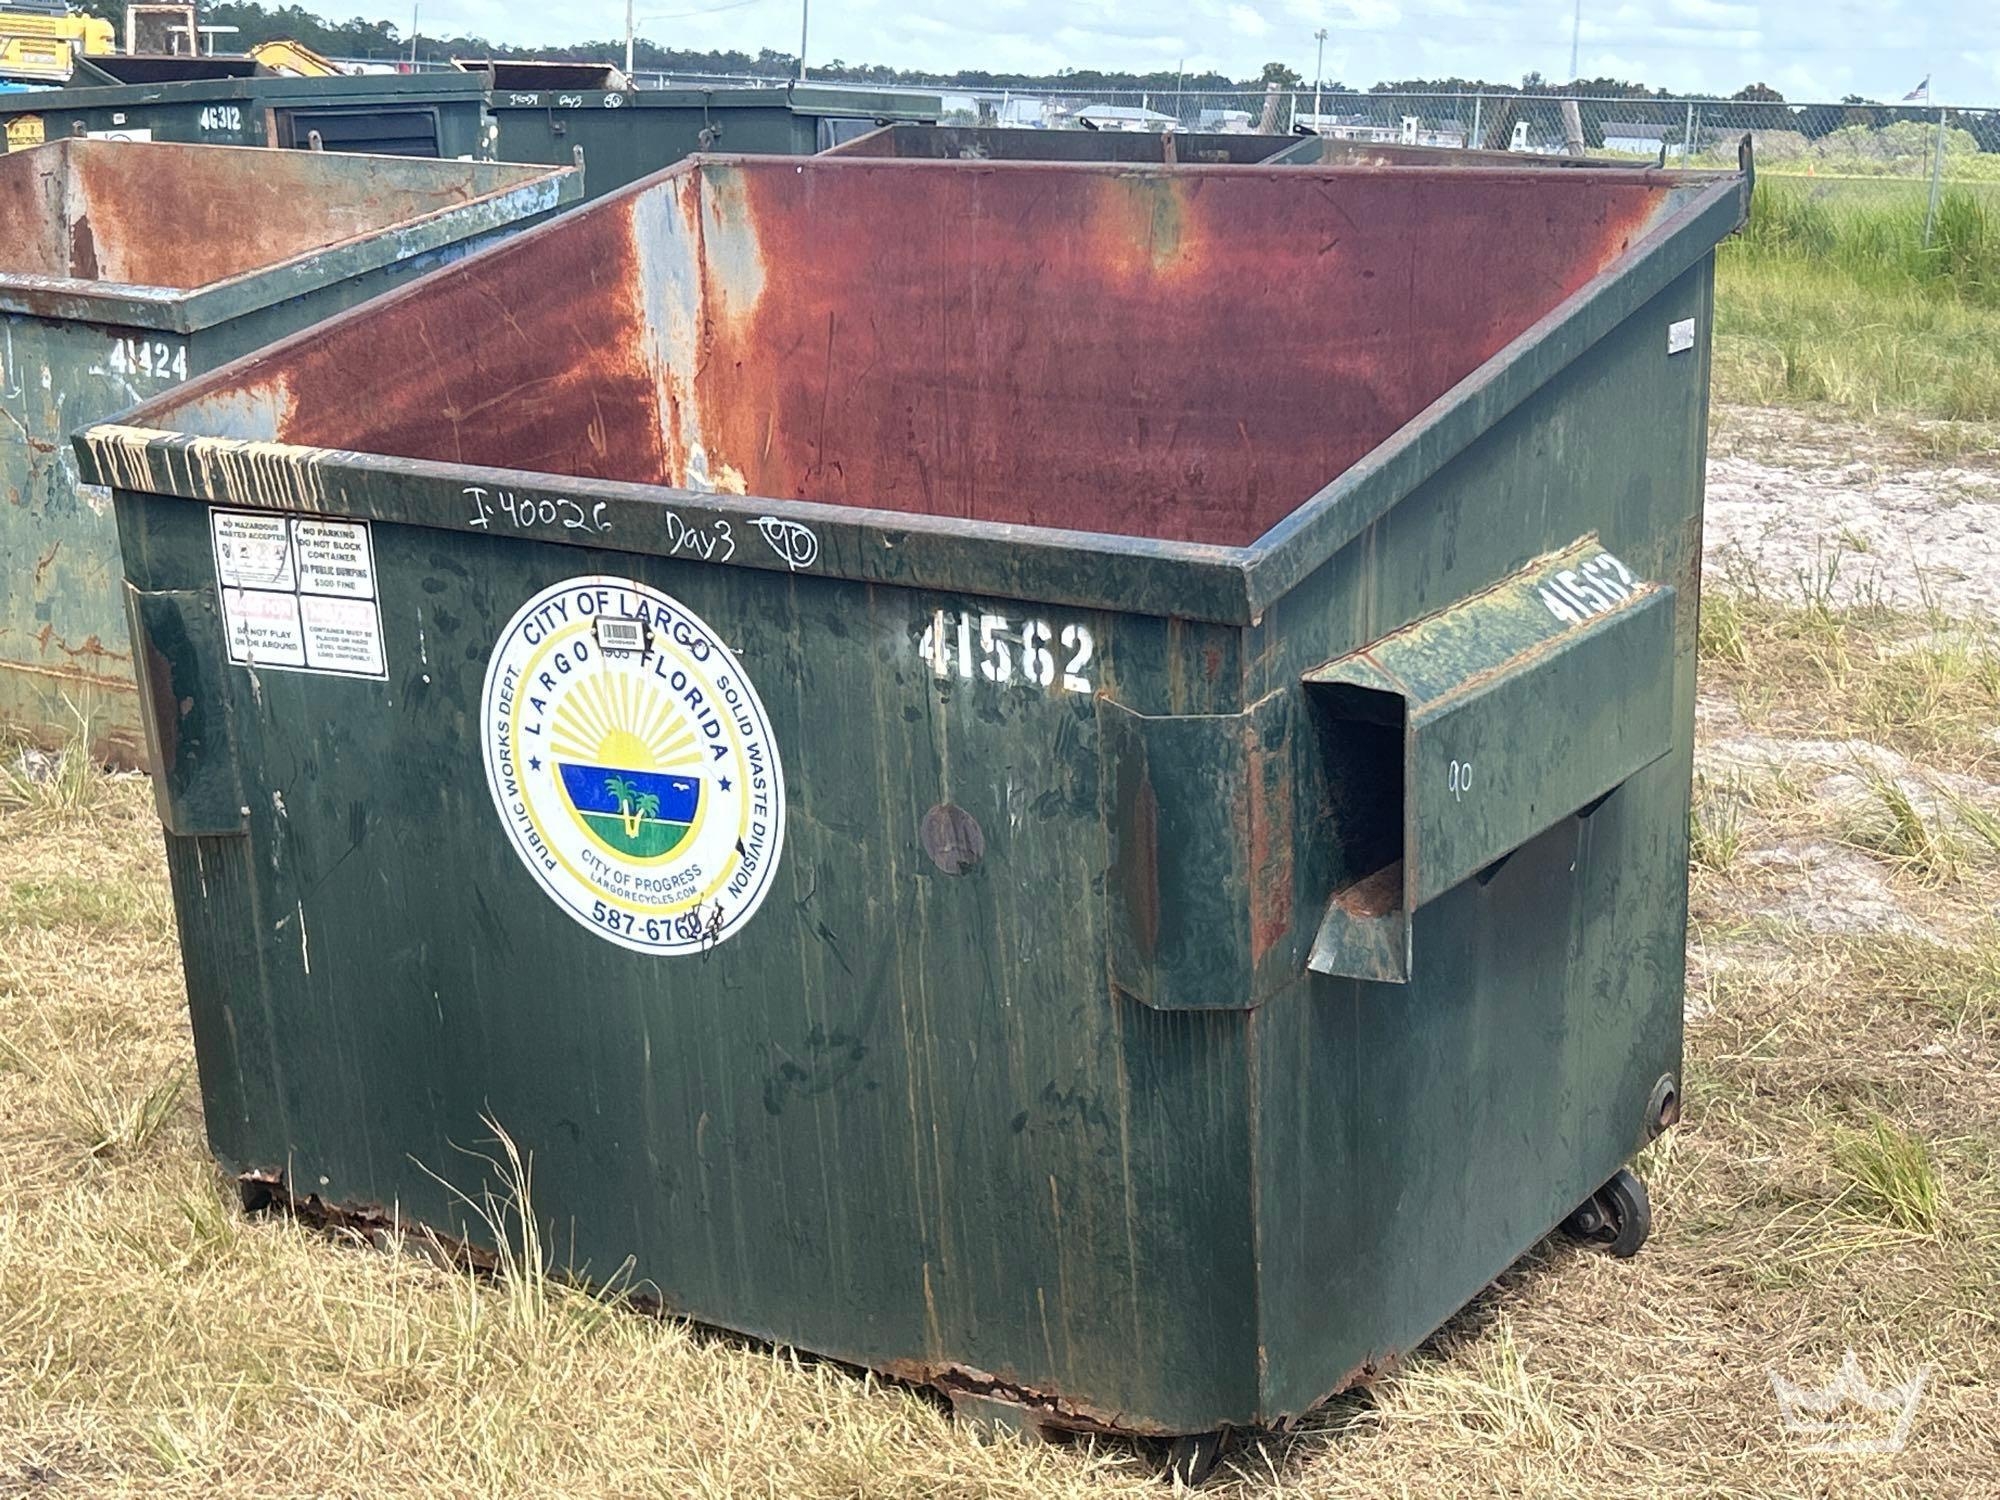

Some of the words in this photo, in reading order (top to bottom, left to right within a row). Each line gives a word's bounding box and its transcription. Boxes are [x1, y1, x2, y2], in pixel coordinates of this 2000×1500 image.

[110, 338, 188, 381] 41424
[235, 522, 279, 531] HAZARDOUS
[248, 533, 286, 541] ACCEPTED
[303, 528, 315, 536] NO
[318, 529, 355, 539] PARKING
[314, 540, 330, 549] NOT
[333, 541, 361, 551] BLOCK
[307, 551, 356, 562] CONTAINER
[310, 565, 334, 575] PUBLIC
[337, 581, 355, 590] FINE
[250, 628, 267, 637] NOT
[270, 630, 291, 639] PLAY
[262, 640, 298, 650] AROUND
[523, 597, 568, 645] CITY
[577, 590, 609, 615] OF
[620, 593, 711, 662] LARGO
[918, 609, 1094, 693] 41562
[525, 640, 589, 735] LARGO
[641, 648, 728, 762] FLORIDA
[716, 675, 753, 736] SOLID
[498, 721, 519, 797] WORKS
[747, 742, 767, 818] WASTE
[513, 802, 557, 870] PUBLIC
[581, 849, 611, 876] CITY
[613, 870, 631, 886] OF
[635, 864, 702, 893] PROGRESS
[728, 821, 766, 899] DIVISION
[590, 872, 698, 905] LARGORECYCLES.COM
